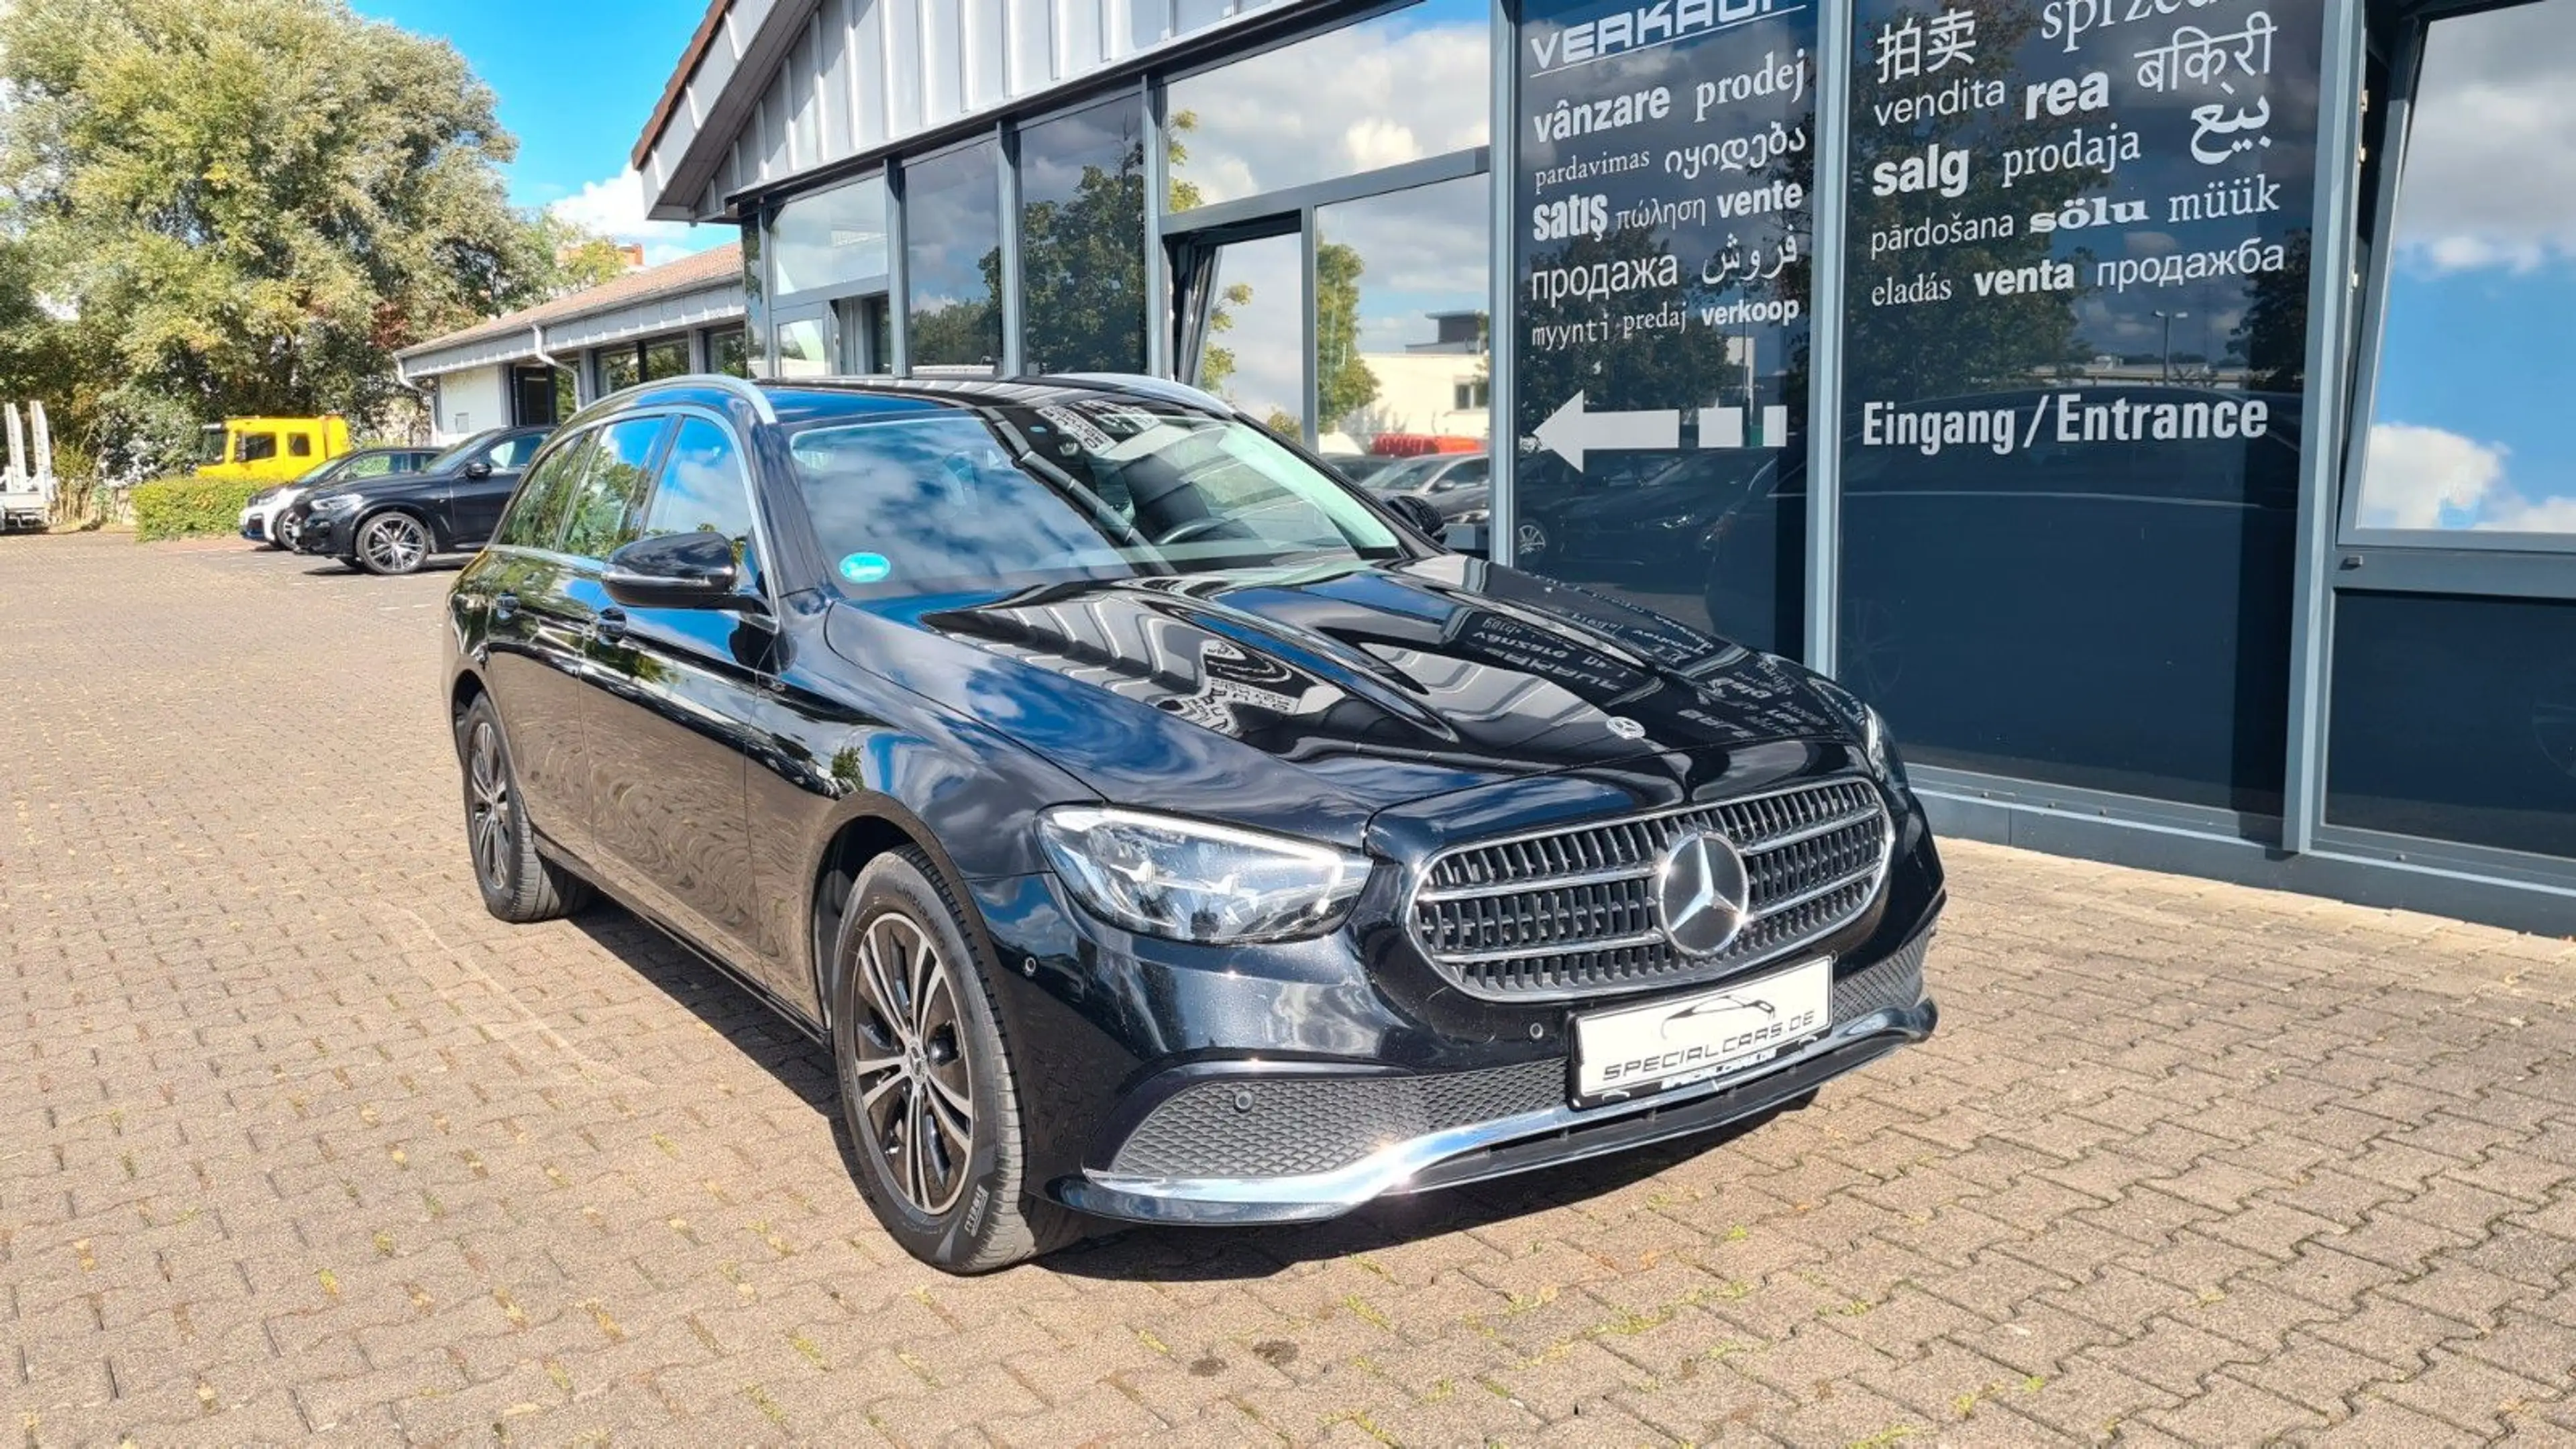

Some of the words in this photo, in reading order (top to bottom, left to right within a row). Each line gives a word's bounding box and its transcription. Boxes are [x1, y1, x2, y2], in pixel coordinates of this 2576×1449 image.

[1876, 8, 1976, 83] 拍卖
[1534, 87, 1670, 142] vânzare
[1695, 49, 1804, 122] prodej
[1874, 80, 2004, 125] vendita
[2026, 72, 2108, 119] rea
[1536, 151, 1649, 195] pardavimas
[1873, 144, 1968, 197] salg
[2002, 123, 2141, 187] prodaja
[1534, 193, 1607, 241] satış
[1615, 199, 1705, 230] πώληση
[1717, 180, 1802, 217] vente
[1872, 213, 2013, 260] pārdošana
[2031, 197, 2149, 233] sölu
[2169, 174, 2280, 222] müük
[1703, 224, 1797, 284] فروش
[2098, 237, 2284, 293] продажба
[1533, 255, 1677, 308] продажа
[1872, 272, 1951, 306] eladás
[1974, 260, 2074, 296] venta
[1533, 309, 1609, 350] myynti
[1623, 301, 1686, 337] predaj
[1701, 300, 1799, 327] verkoop
